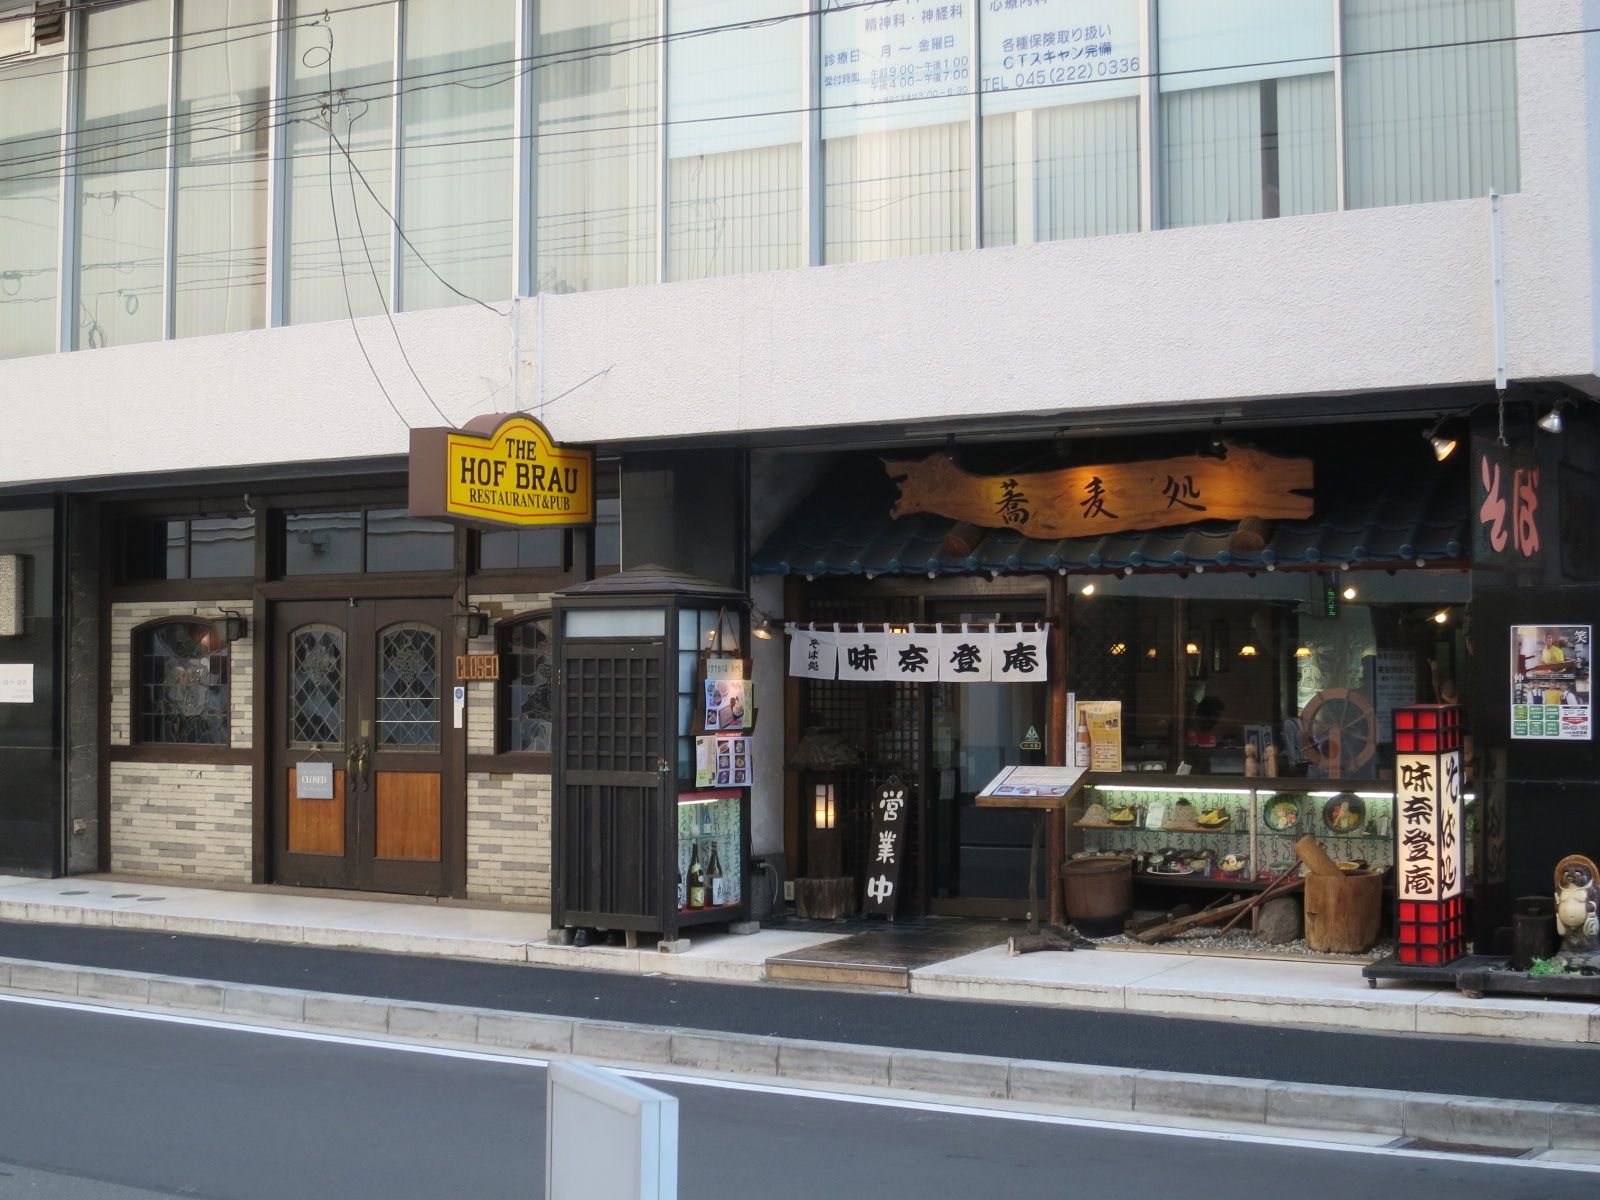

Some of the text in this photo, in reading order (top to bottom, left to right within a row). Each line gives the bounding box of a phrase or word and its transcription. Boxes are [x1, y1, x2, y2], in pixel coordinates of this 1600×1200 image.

[1002, 25, 1112, 52] 各種保険取り扱い
[824, 49, 860, 67] 診療日
[982, 76, 1008, 92] TEL
[505, 438, 537, 461] THE
[460, 456, 578, 494] HOF BRAU
[469, 487, 570, 511] RESTAURANT&PUB
[456, 655, 499, 679] CLOSED
[847, 642, 1038, 673] 味奈登庵
[301, 775, 327, 784] CLOSED
[1400, 761, 1435, 896] 味奈登庵
[867, 790, 904, 904] 営業中
